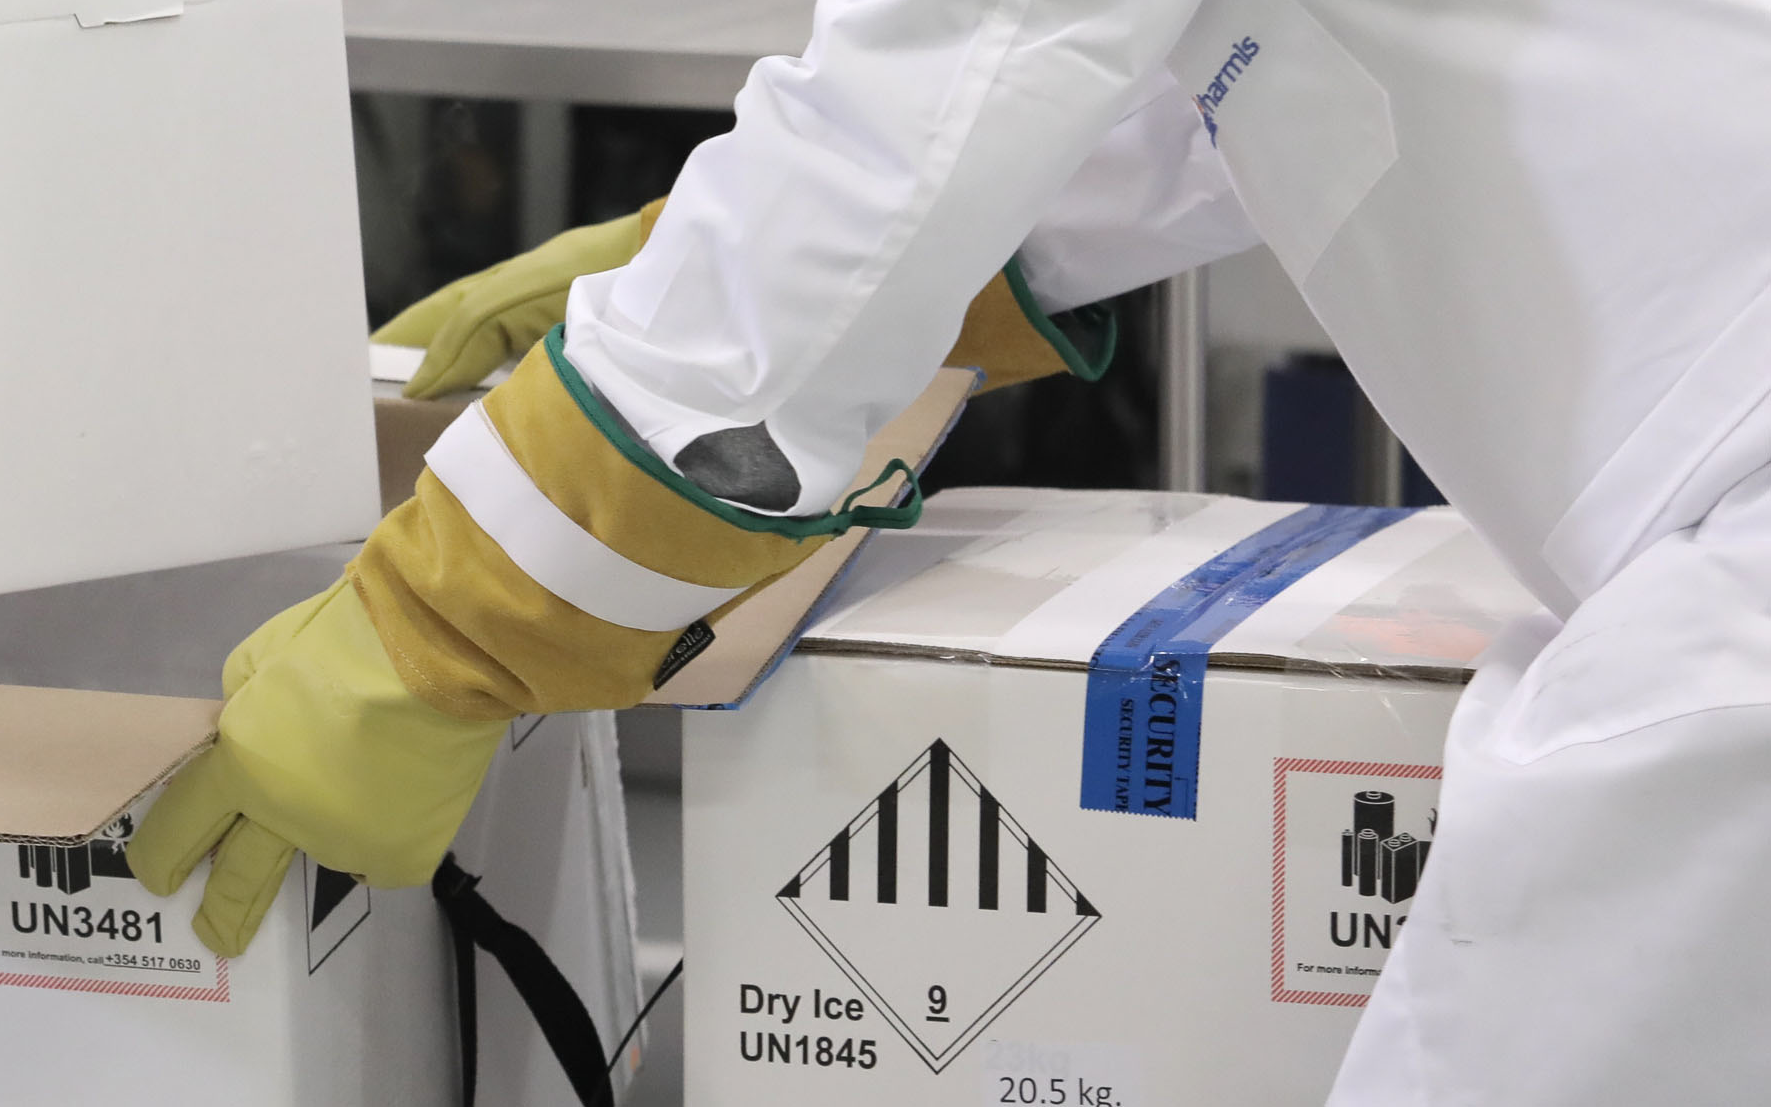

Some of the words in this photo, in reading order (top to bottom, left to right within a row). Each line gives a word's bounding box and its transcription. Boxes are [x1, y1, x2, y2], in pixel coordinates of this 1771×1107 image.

[1194, 36, 1260, 131] harmis
[1116, 698, 1134, 771] SECURITY
[1143, 658, 1181, 818] SECURITY
[11, 900, 163, 944] UN3481
[1330, 911, 1408, 949] UN
[1, 949, 26, 960] more
[28, 950, 86, 965] information,
[87, 955, 104, 965] call
[105, 953, 137, 966] +354
[142, 955, 165, 968] 517
[169, 957, 201, 971] 0630
[1297, 962, 1314, 973] For
[1316, 965, 1343, 975] more
[740, 983, 801, 1025] Dry
[814, 988, 864, 1021] Ice
[927, 984, 948, 1019] 9
[740, 1031, 878, 1070] UN1845
[999, 1076, 1067, 1105] 20.5
[1078, 1077, 1122, 1107] kg.
